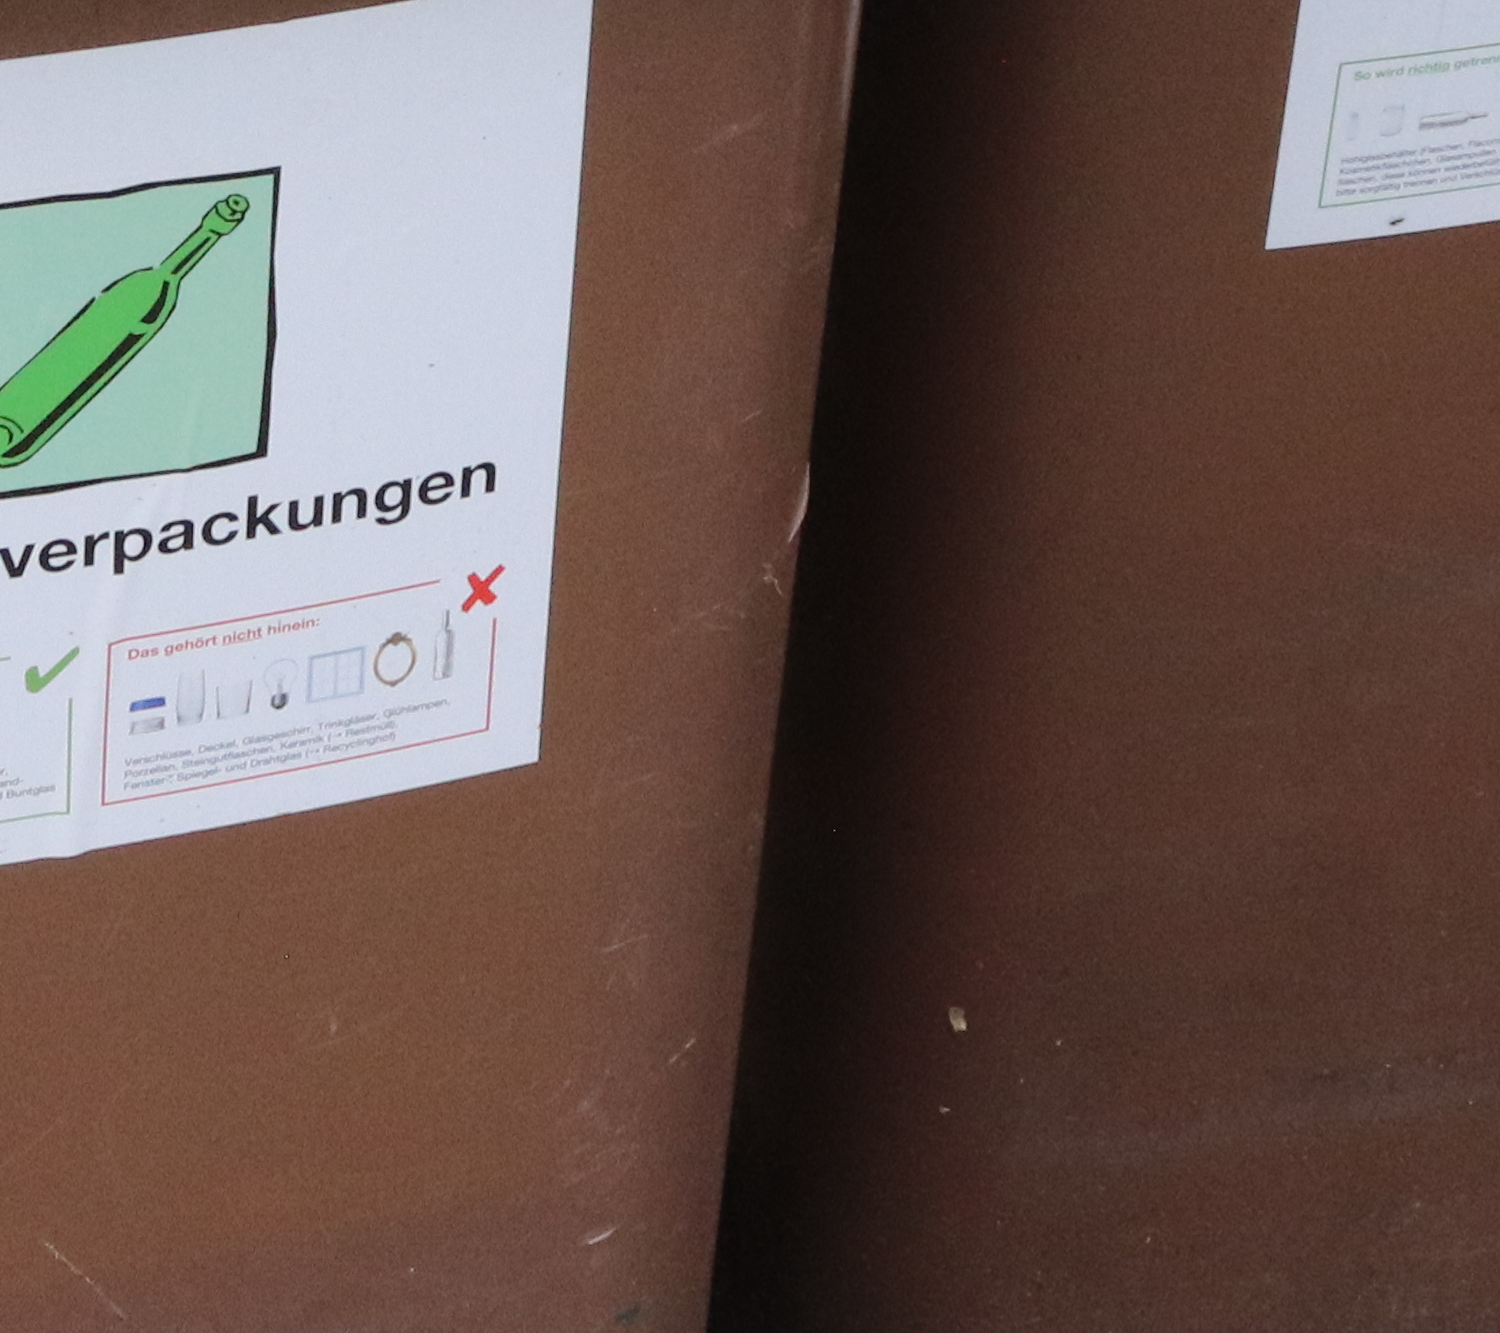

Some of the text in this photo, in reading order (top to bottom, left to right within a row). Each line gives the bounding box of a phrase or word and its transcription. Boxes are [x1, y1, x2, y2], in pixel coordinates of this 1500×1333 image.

[1354, 71, 1371, 81] So
[1375, 66, 1404, 78] wird
[1408, 61, 1450, 76] richtig
[128, 618, 320, 660] Das gehört nicht hinein:
[225, 761, 246, 773] und
[6, 783, 56, 800] Buntglas
